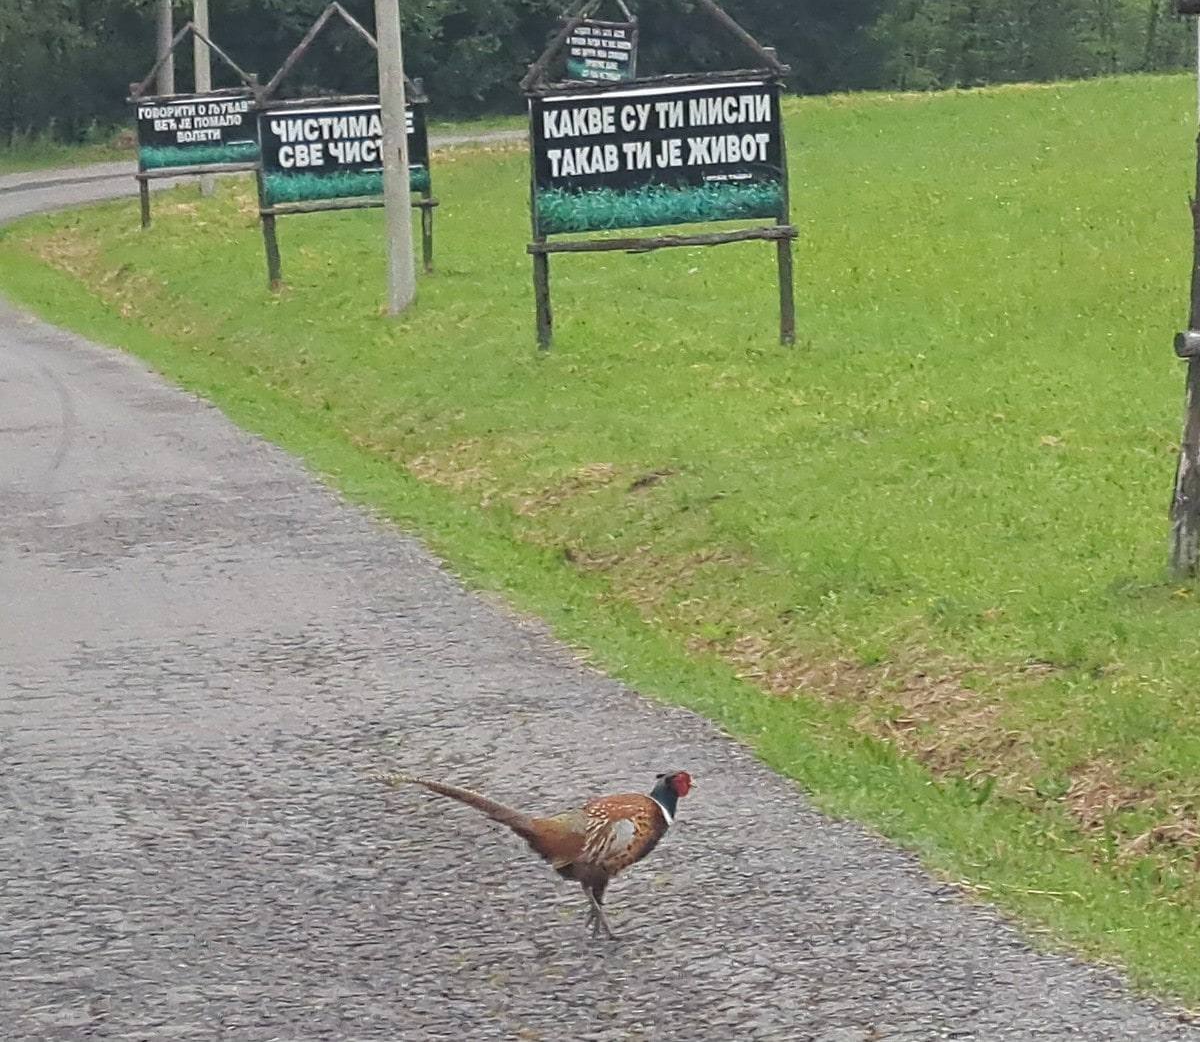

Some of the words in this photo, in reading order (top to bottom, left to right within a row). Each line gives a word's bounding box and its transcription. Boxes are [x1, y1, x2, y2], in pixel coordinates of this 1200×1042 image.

[138, 105, 196, 119] ГОВОРИТИ
[543, 106, 615, 139] КАКВЕ
[620, 104, 650, 132] СУ
[656, 101, 683, 129] ТИ
[689, 94, 771, 127] МИСЛИ
[270, 114, 383, 142] ЧИСТИМА
[278, 143, 324, 168] СВЕ
[547, 144, 619, 178] ТАКАВ
[623, 141, 651, 170] ТИ
[656, 139, 682, 168] ЈЕ
[688, 133, 770, 165] ЖИВОТ
